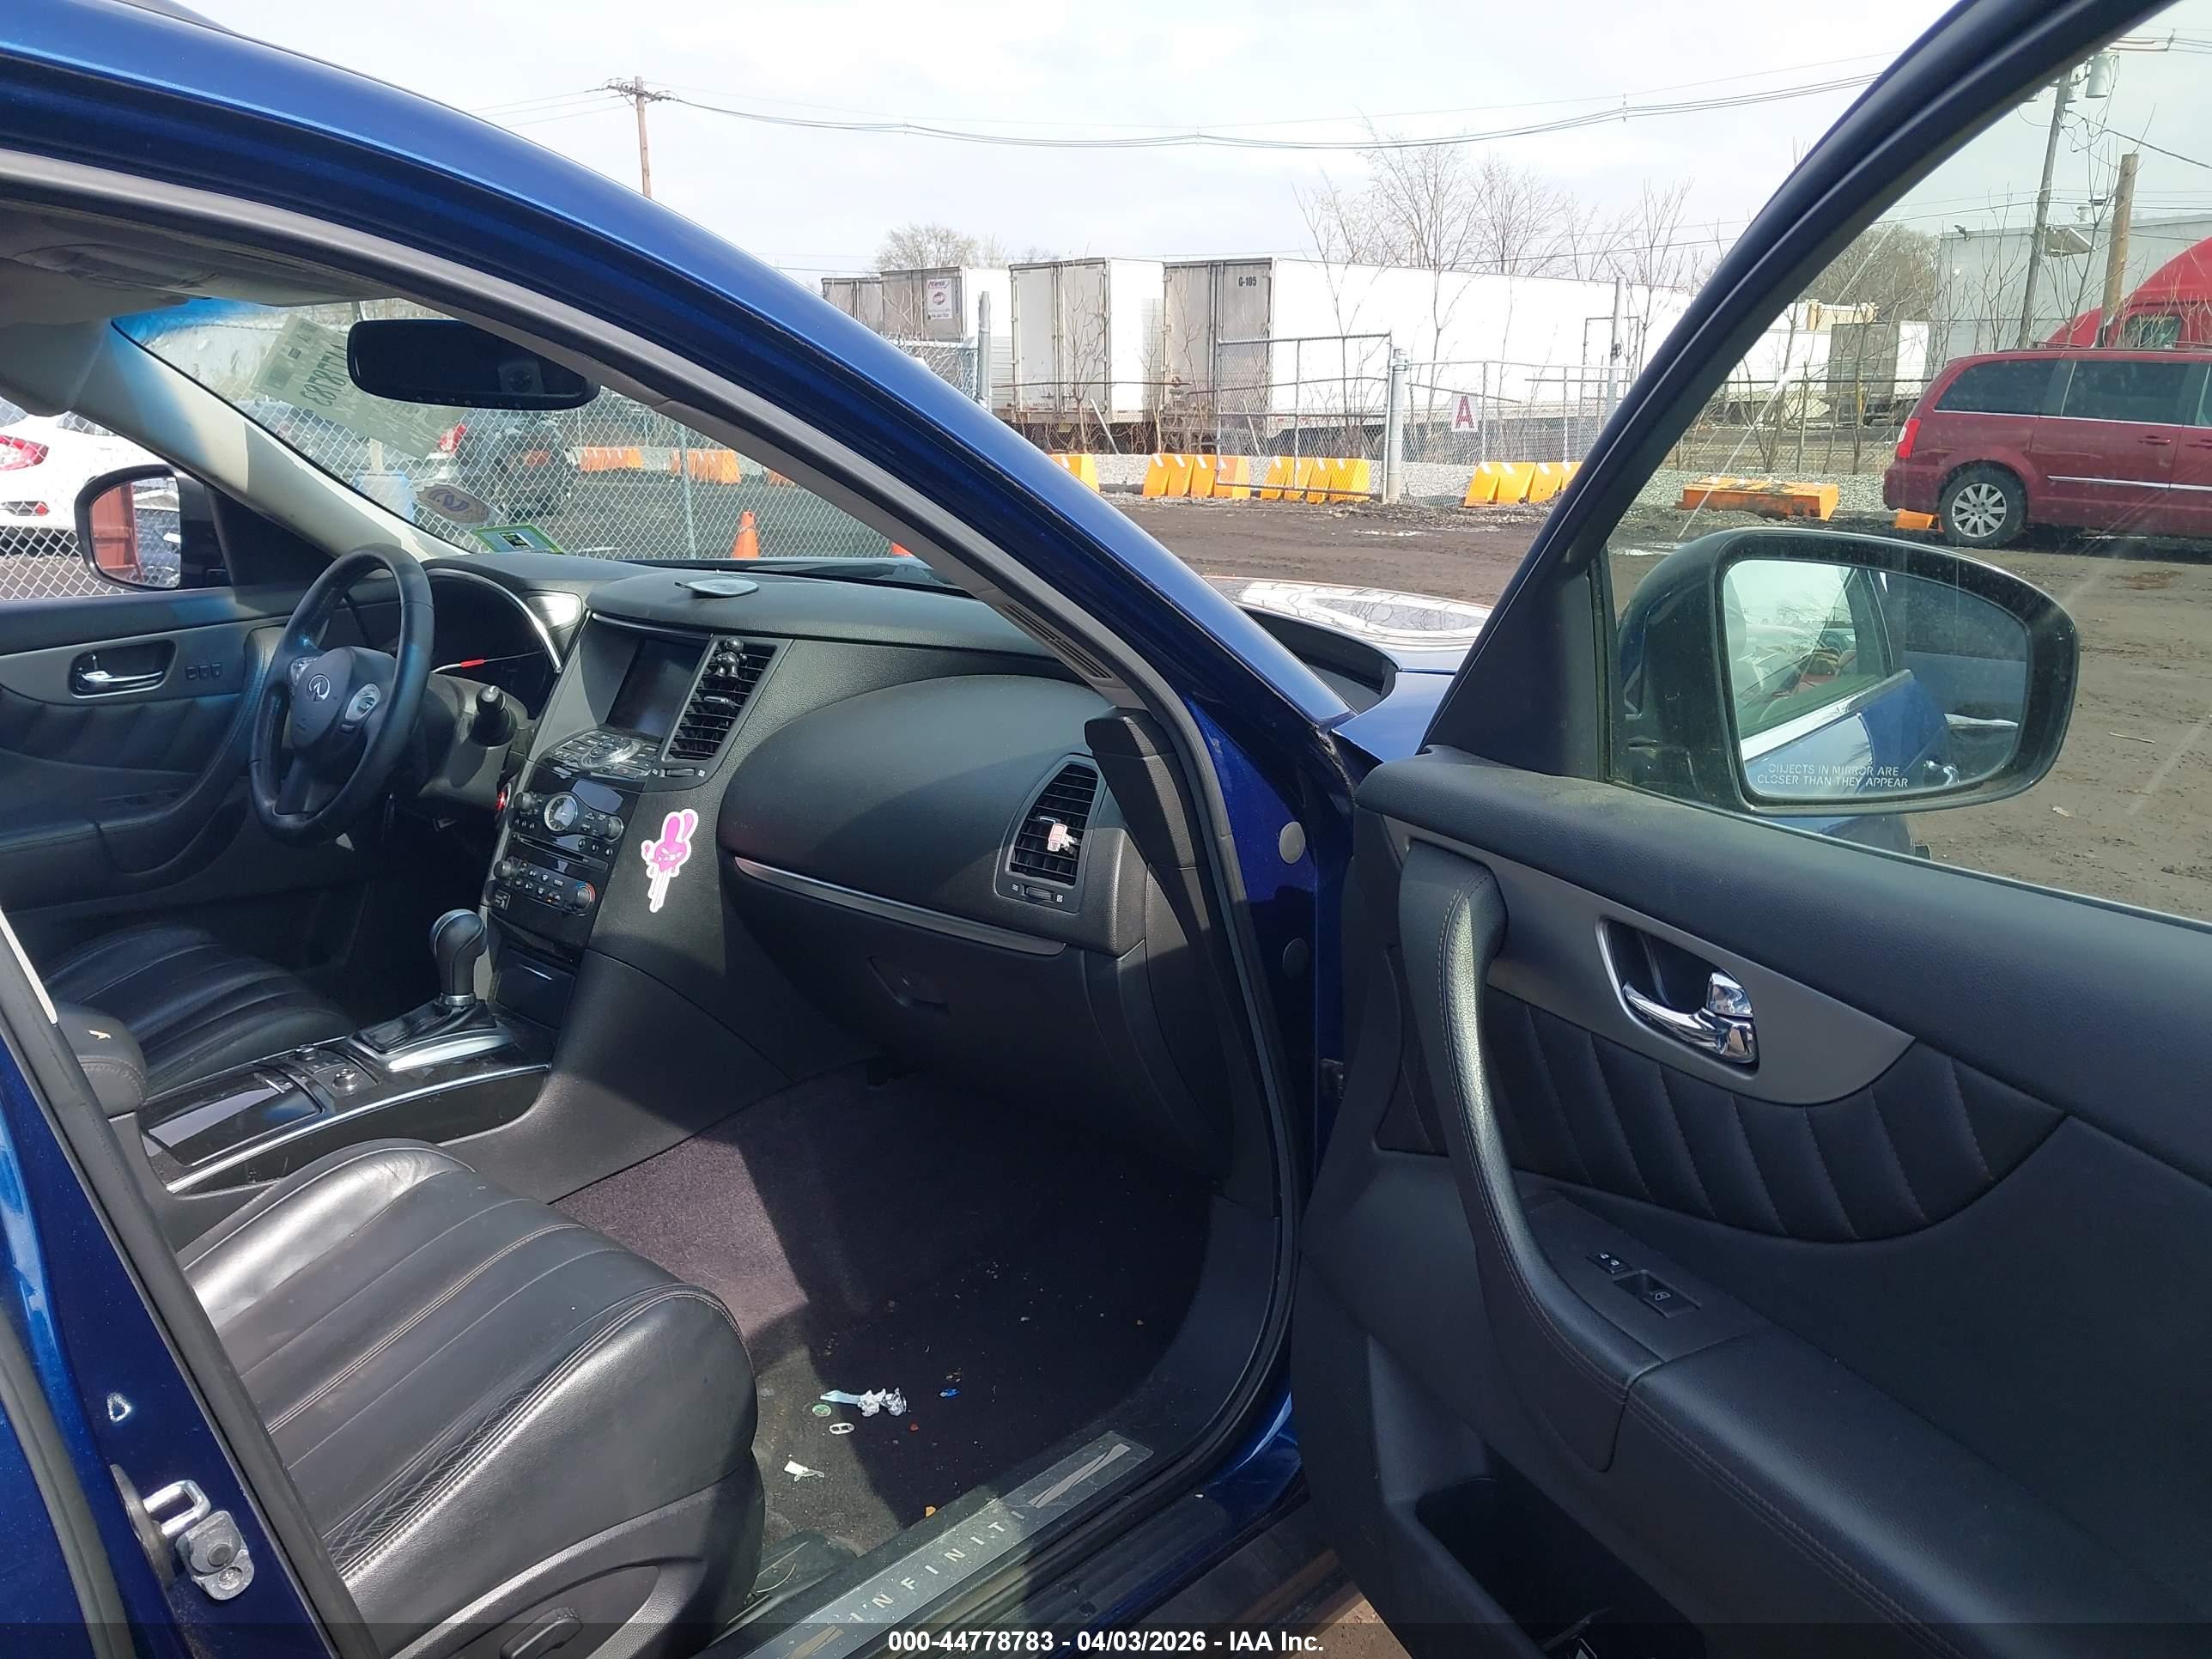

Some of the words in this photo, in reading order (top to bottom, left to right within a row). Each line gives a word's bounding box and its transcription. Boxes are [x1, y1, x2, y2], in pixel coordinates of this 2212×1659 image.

[1238, 276, 1257, 287] G-105
[1455, 396, 1474, 428] A
[1768, 763, 1814, 775] OBJECTS
[1818, 764, 1829, 775] IN
[1832, 764, 1873, 776] MIRROR
[1877, 766, 1899, 777] ARE
[1757, 775, 1799, 785] CLOSER
[1803, 775, 1832, 786] THAN
[1836, 776, 1862, 787] THEY
[1865, 777, 1908, 788] APPEAR
[850, 1510, 1025, 1622] INFINITI
